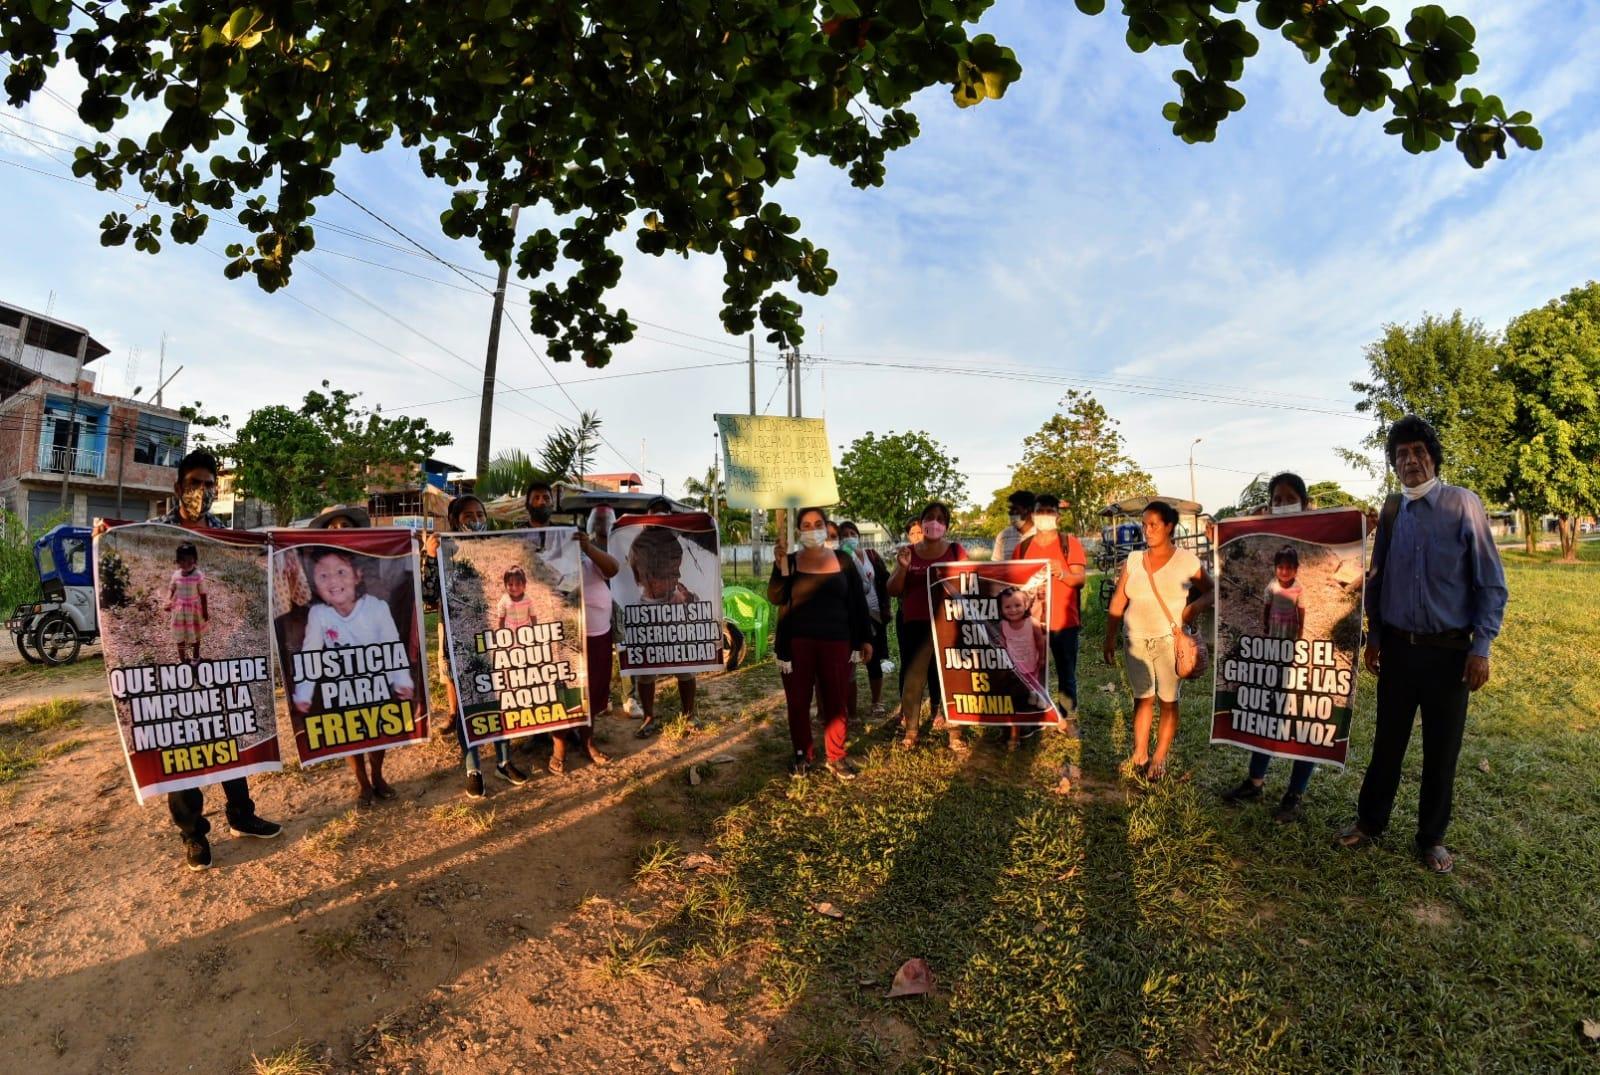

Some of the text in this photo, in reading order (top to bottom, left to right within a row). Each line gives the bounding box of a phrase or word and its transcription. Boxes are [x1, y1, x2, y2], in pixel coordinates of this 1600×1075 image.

[959, 572, 980, 596] LA
[625, 601, 712, 625] JUSTICIA SIN
[944, 598, 1000, 621] FUERZA
[517, 622, 564, 647] QUE
[624, 621, 721, 645] MISERICORDIA
[961, 624, 990, 646] SIN
[292, 643, 410, 683] JUSTICIA
[494, 641, 552, 670] AQUÍ
[626, 642, 716, 665] ES CRUELDAD
[945, 649, 1014, 670] JUSTICIA
[1239, 636, 1336, 667] SOMOS EL
[110, 657, 268, 698] QUE NO QUEDE
[321, 675, 390, 709] PARA
[475, 661, 577, 693] SE HACE,
[971, 672, 991, 693] ES
[1224, 659, 1352, 697] GRITO DE LAS
[131, 685, 253, 723] IMPUNE LA
[500, 680, 558, 711] AQUÍ
[953, 694, 1015, 715] TIRANIA
[1236, 685, 1333, 722] QUE YA NO
[133, 711, 257, 752] MUERTE DE
[305, 703, 415, 750] FREYSI
[471, 714, 502, 736] SE
[1231, 709, 1337, 748] TIENEN VOZ
[161, 740, 240, 775] FREYSI
